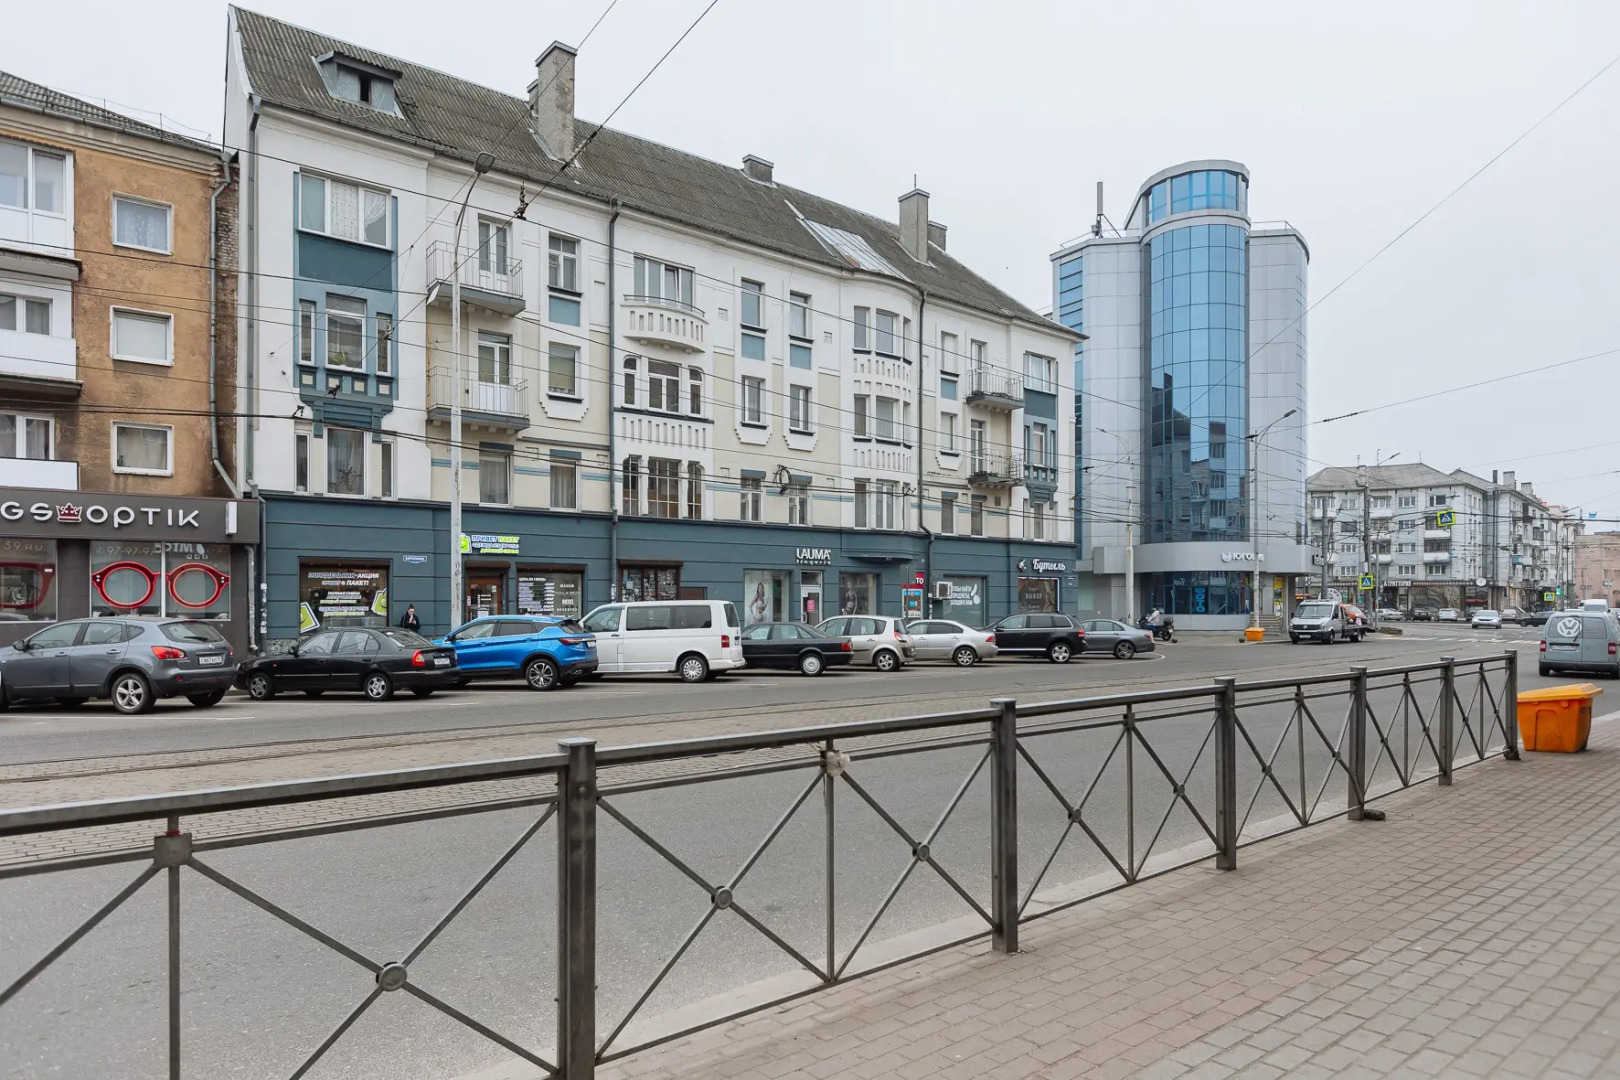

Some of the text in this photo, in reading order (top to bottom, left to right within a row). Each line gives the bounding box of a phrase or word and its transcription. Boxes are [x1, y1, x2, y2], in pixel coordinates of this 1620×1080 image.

[86, 505, 199, 528] OPTIK
[797, 548, 830, 560] LAUMA
[1032, 558, 1066, 573] Бутыль
